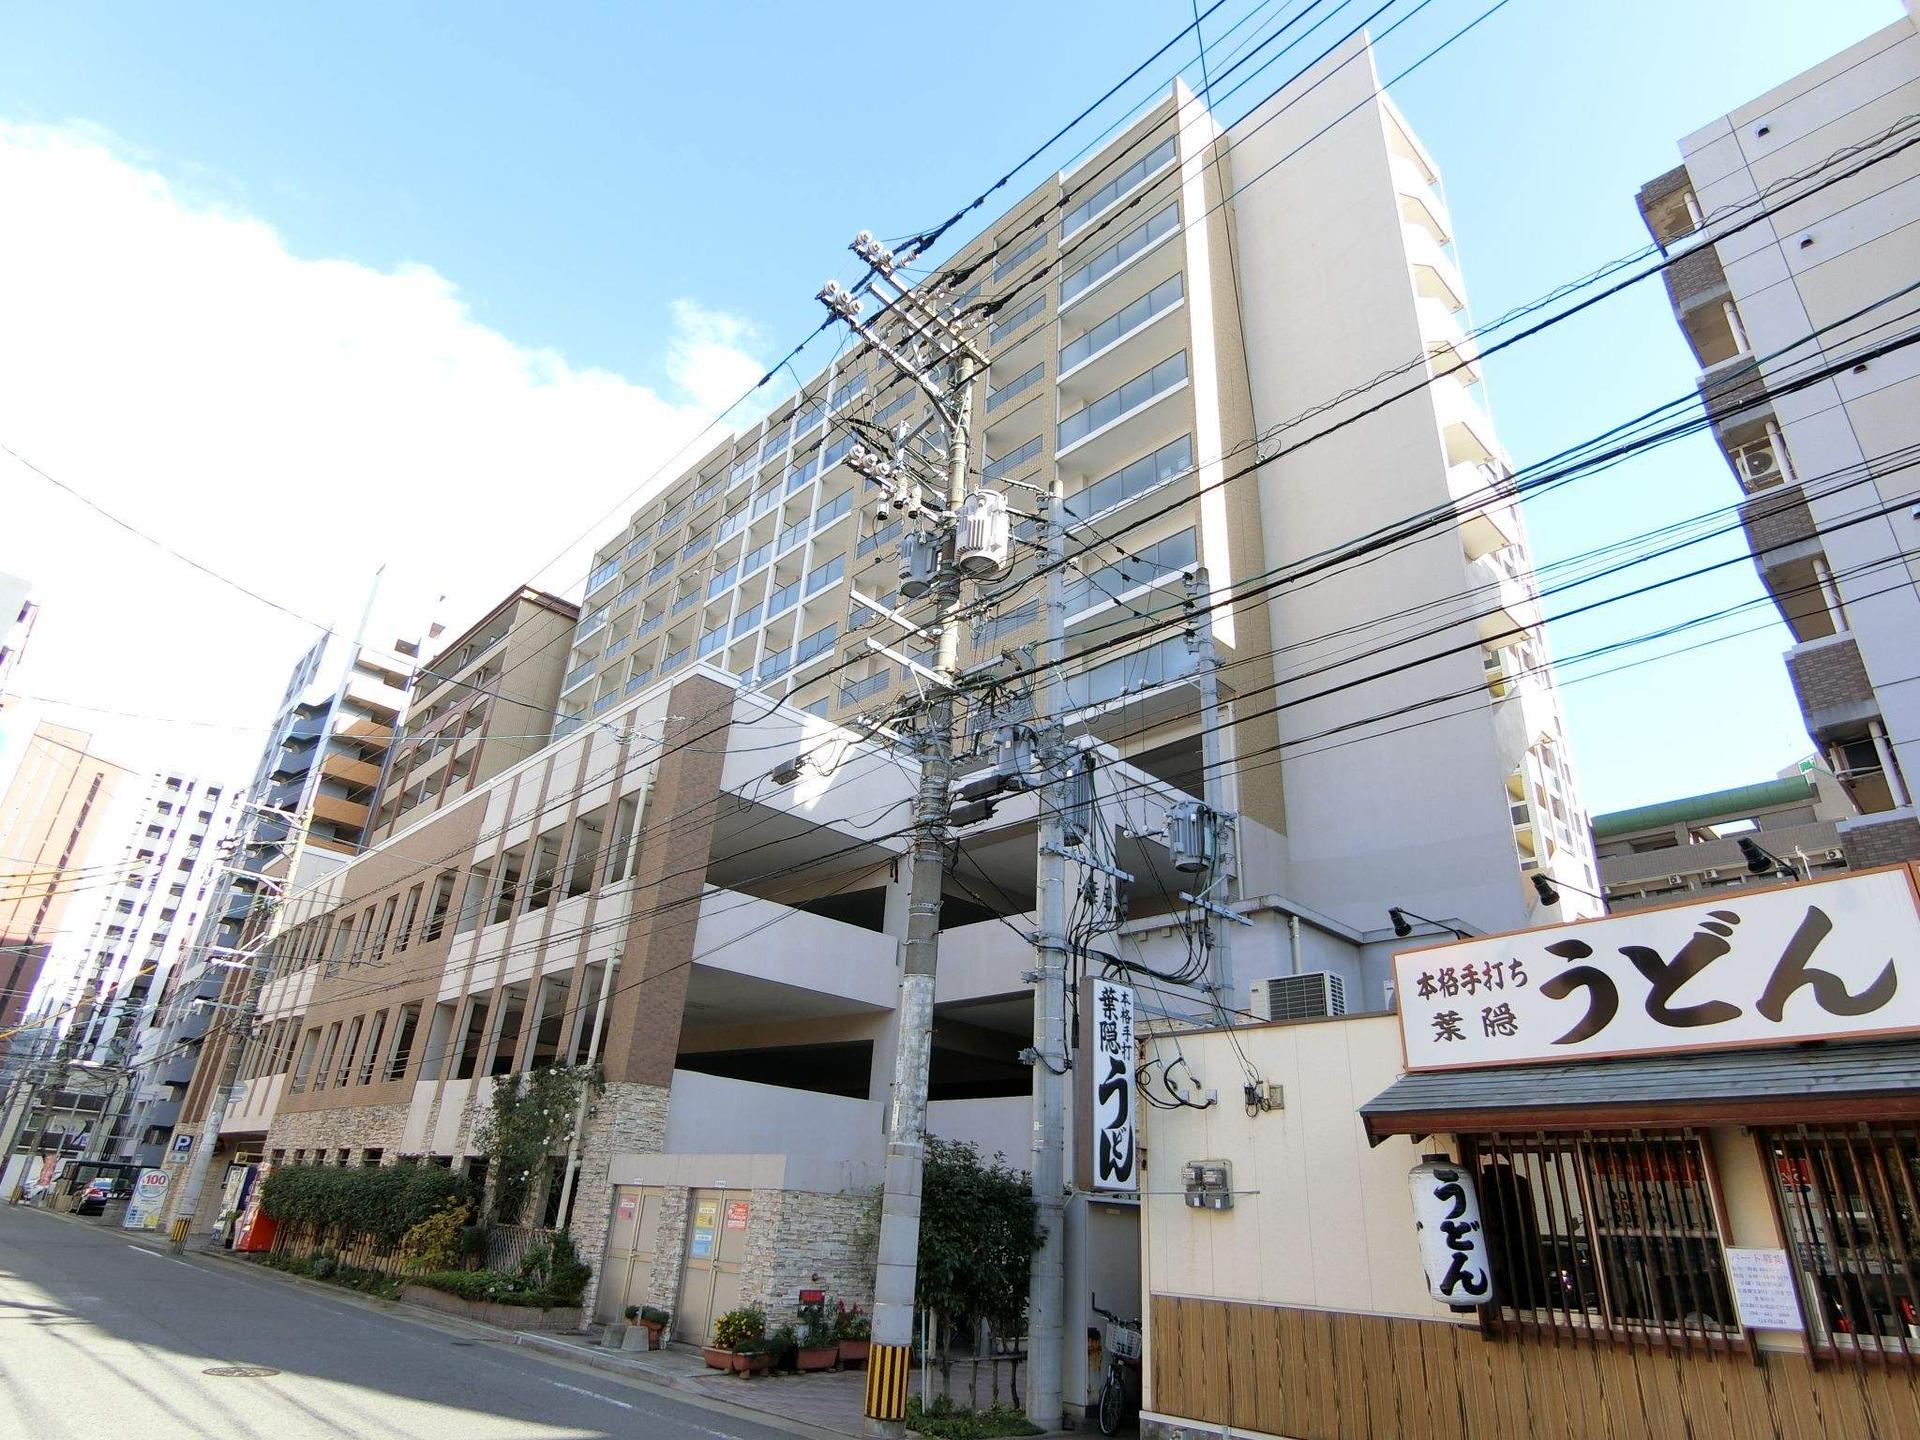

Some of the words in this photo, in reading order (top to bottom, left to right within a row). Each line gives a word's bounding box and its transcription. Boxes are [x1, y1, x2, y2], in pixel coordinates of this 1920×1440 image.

[1416, 957, 1529, 1002] 本格手打ち
[1538, 904, 1898, 1046] うどん
[1098, 986, 1121, 1055] 葉隠
[1120, 991, 1133, 1061] 本格手打
[1430, 1002, 1519, 1044] 葉隠
[175, 1136, 191, 1151] P
[1098, 1056, 1134, 1183] うどん
[1433, 1169, 1489, 1296] うどん
